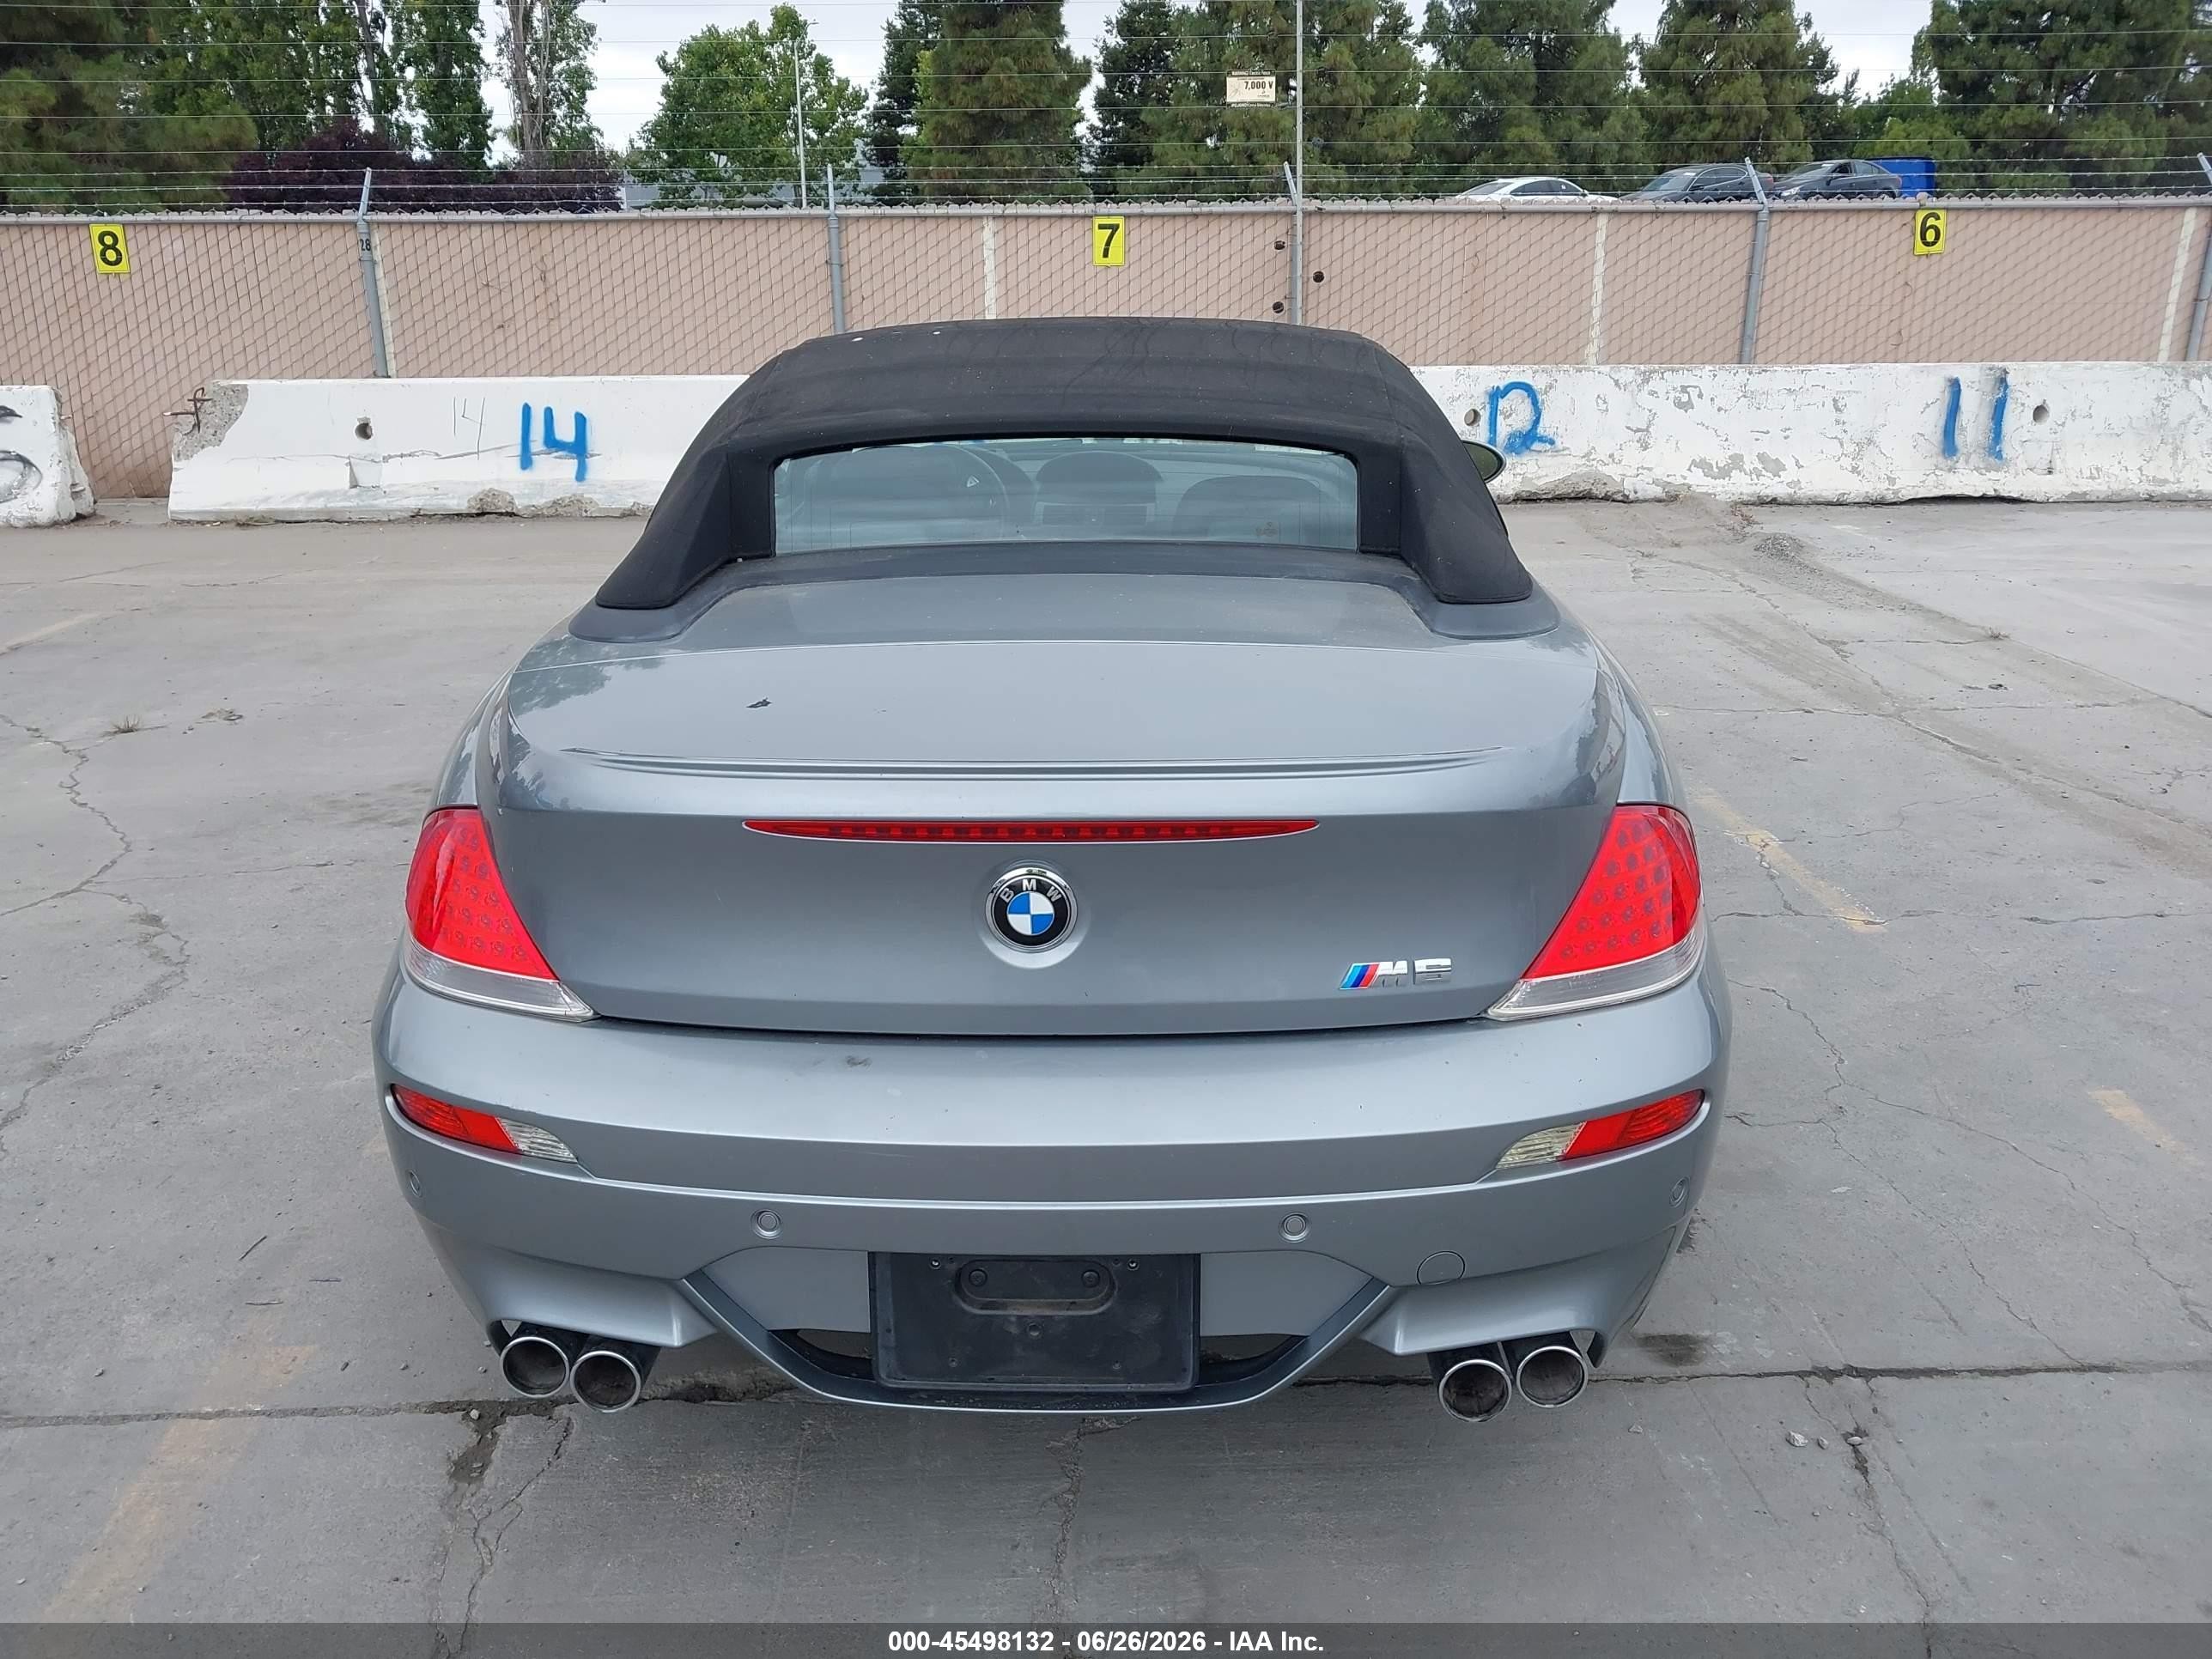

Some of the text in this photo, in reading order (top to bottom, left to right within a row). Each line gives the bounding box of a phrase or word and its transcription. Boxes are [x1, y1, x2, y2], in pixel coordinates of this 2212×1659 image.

[1244, 81, 1274, 91] 7,000 V
[360, 239, 371, 251] 28
[1097, 223, 1121, 258] 7
[1920, 211, 1941, 247] 6
[98, 230, 123, 266] 8
[1487, 381, 1556, 455] 12
[1942, 376, 2009, 462] 11
[520, 401, 587, 482] 14
[1000, 878, 1062, 903] BMW
[1364, 957, 1452, 988] M6
